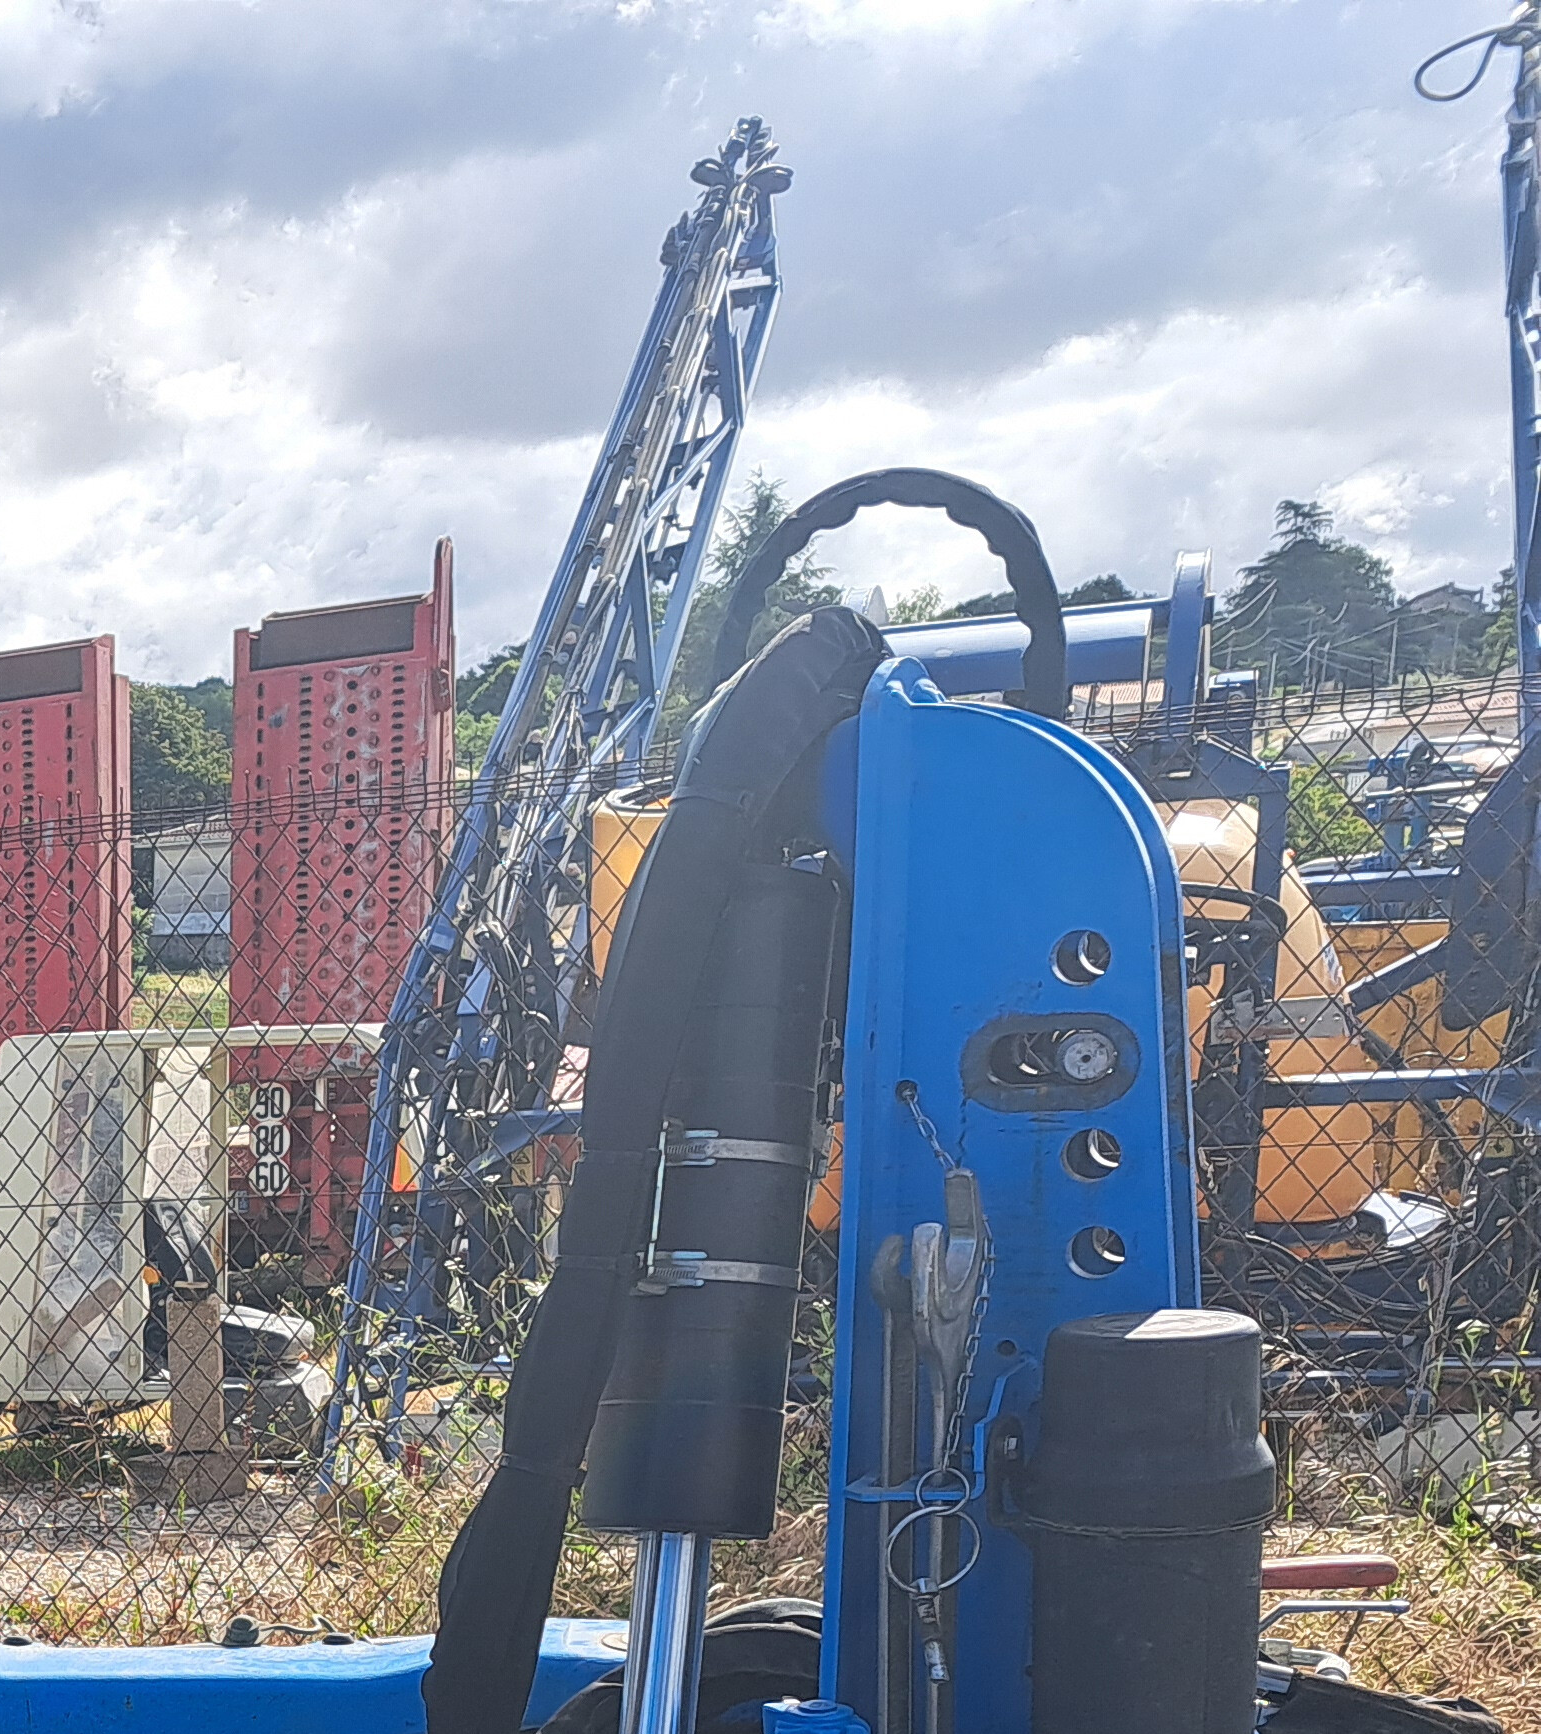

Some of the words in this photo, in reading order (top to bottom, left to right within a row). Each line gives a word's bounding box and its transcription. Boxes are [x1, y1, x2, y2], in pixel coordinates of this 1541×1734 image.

[255, 1086, 284, 1119] 90
[255, 1124, 284, 1157] 80
[255, 1161, 284, 1193] 60
